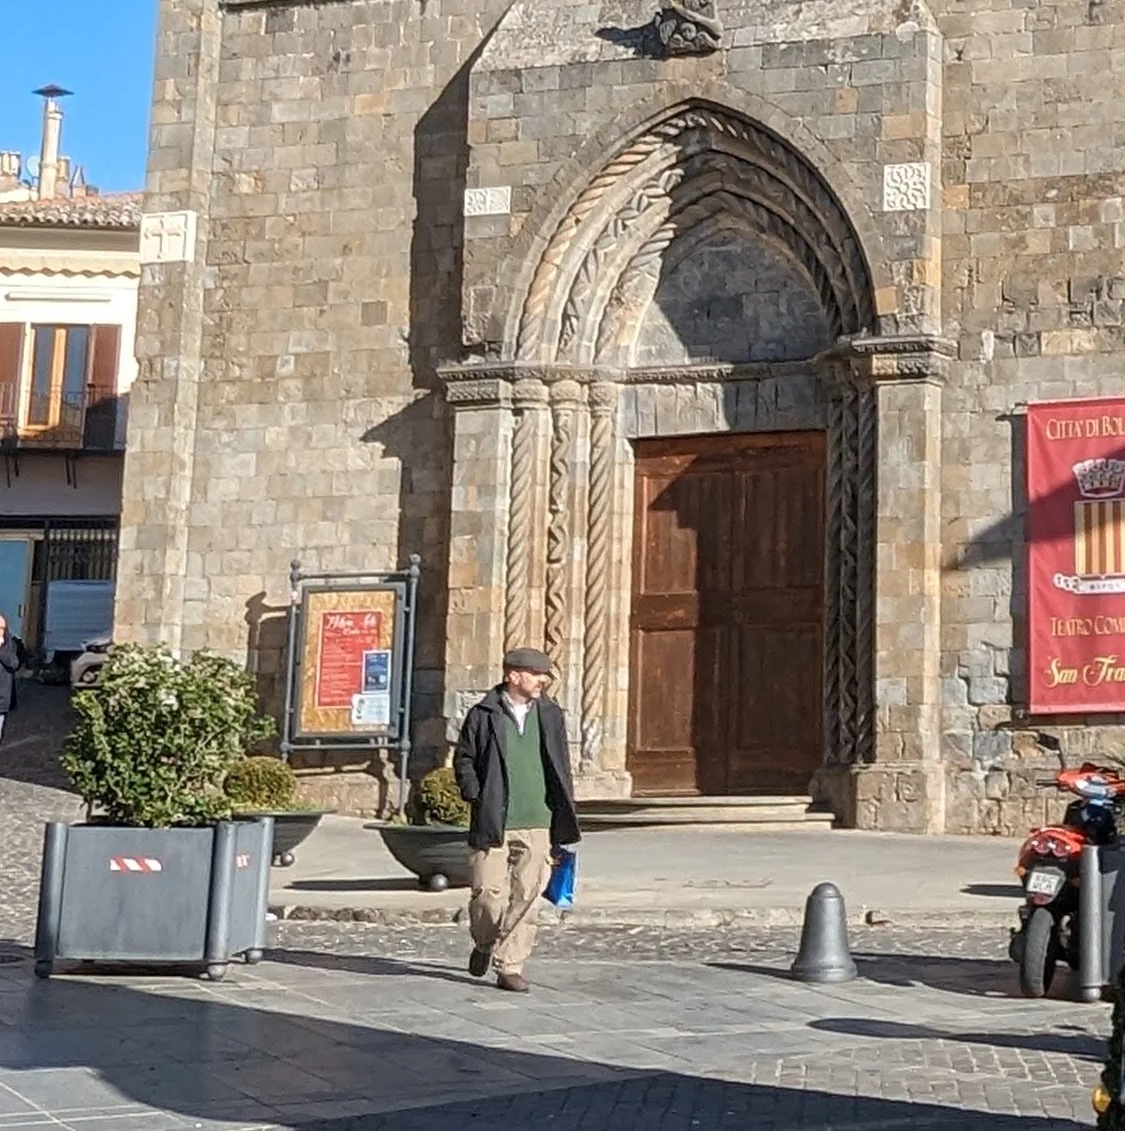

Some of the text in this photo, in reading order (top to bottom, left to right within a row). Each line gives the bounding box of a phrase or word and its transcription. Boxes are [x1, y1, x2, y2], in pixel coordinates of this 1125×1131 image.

[1086, 418, 1100, 438] DI
[1050, 616, 1093, 637] TEATRO
[1043, 656, 1078, 688] San
